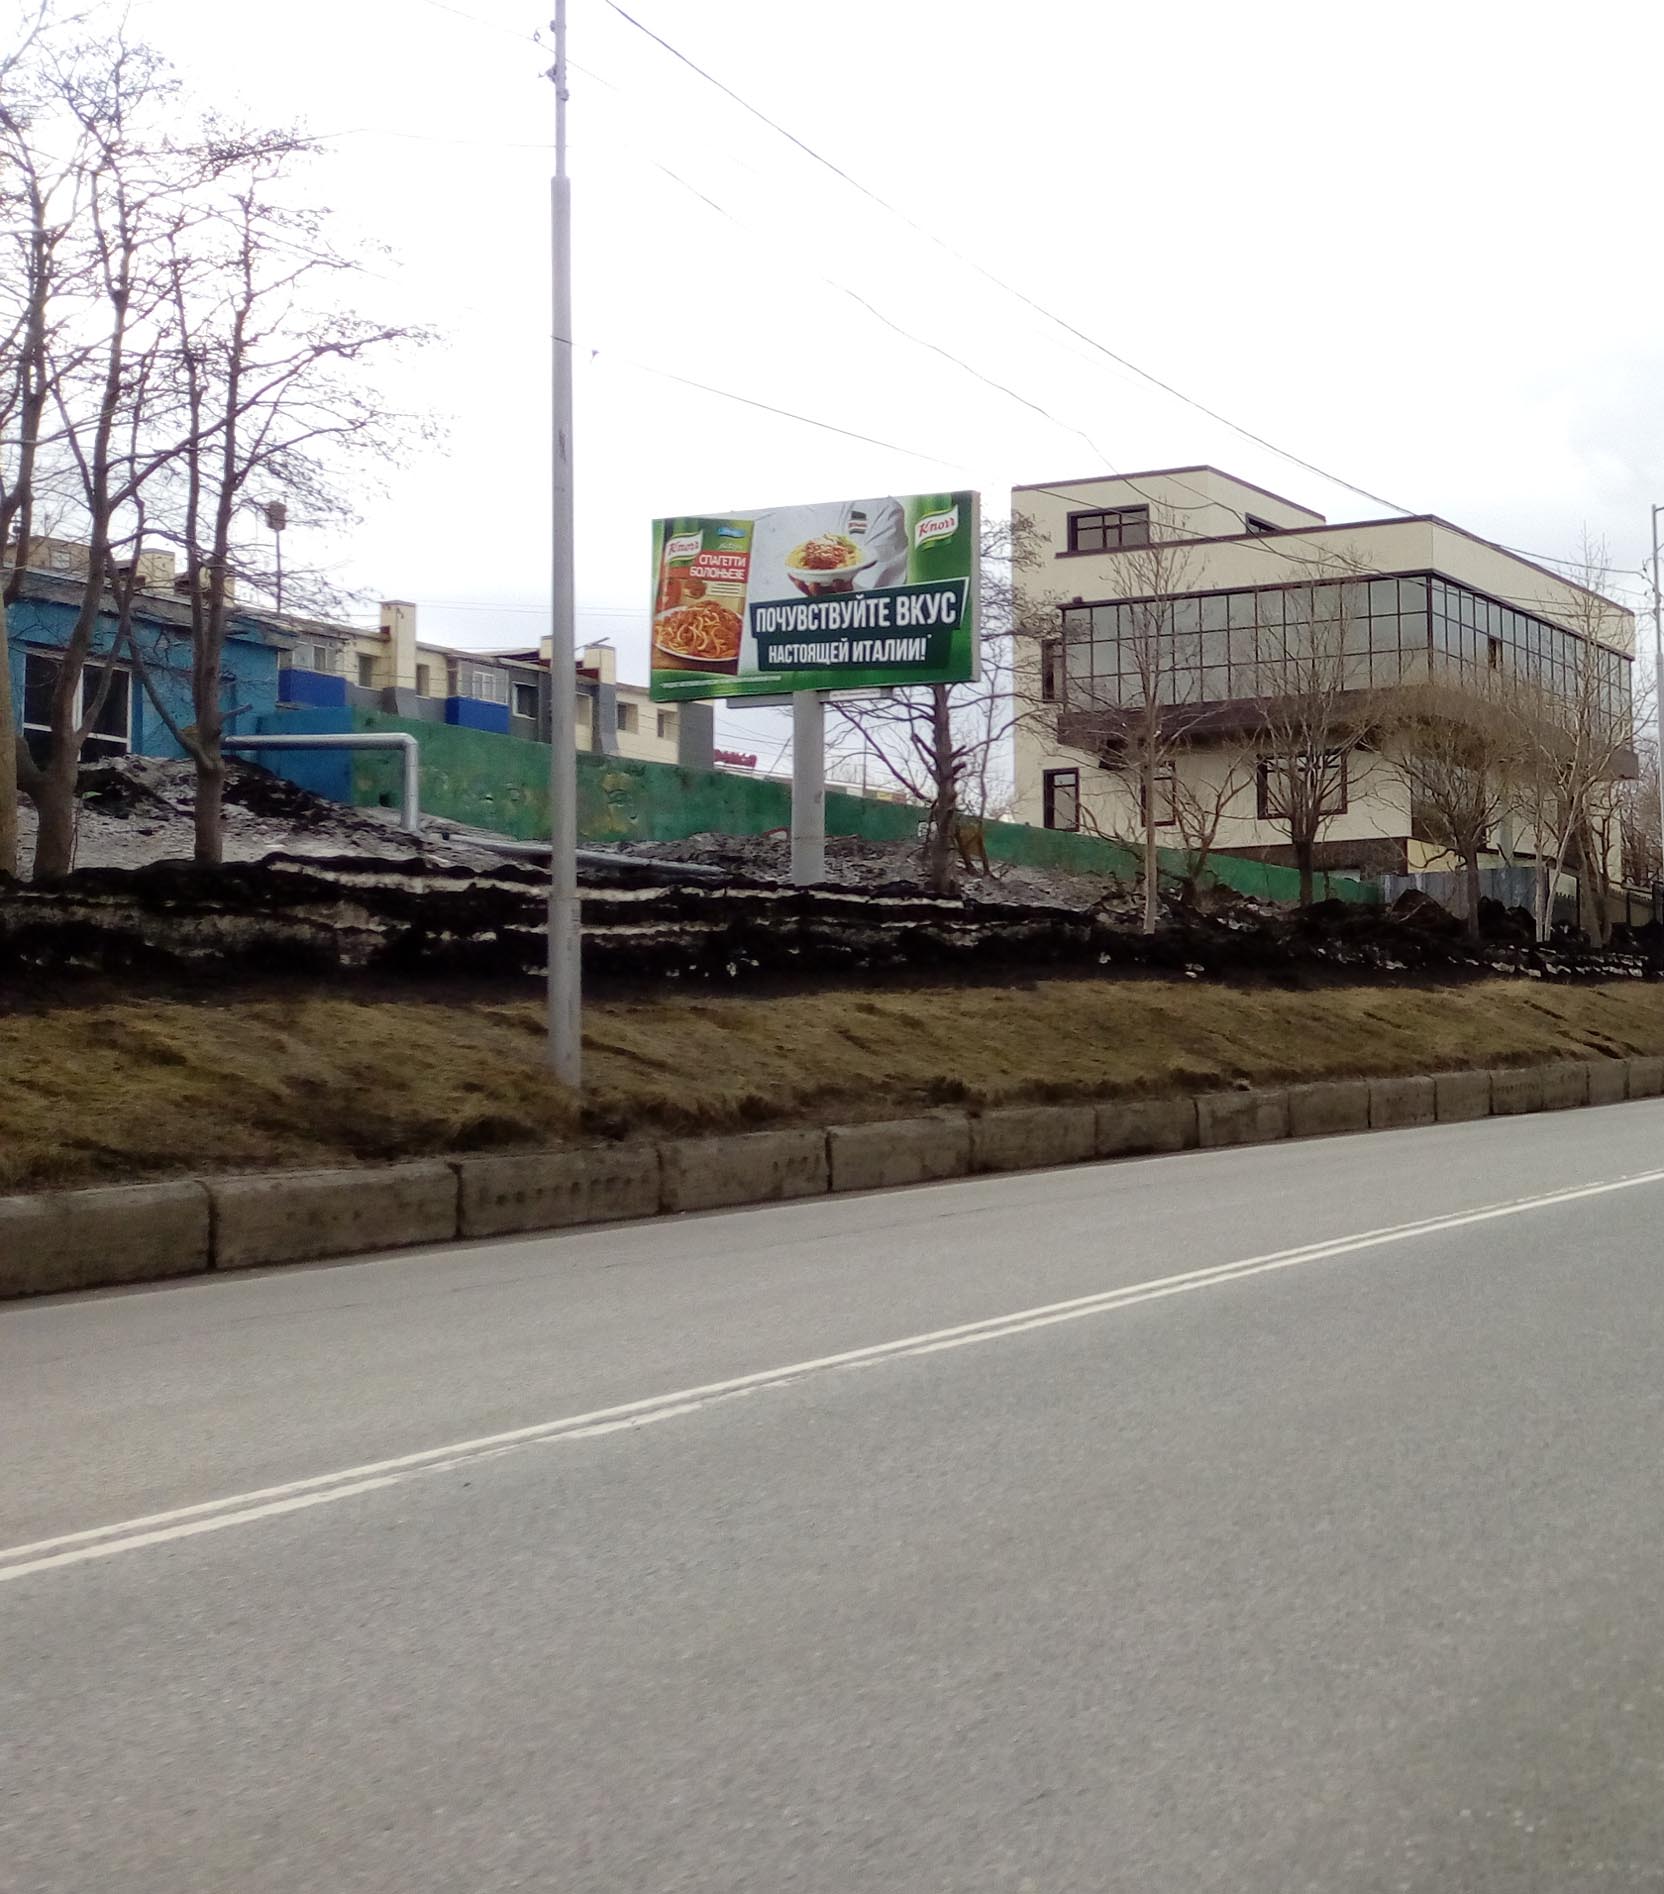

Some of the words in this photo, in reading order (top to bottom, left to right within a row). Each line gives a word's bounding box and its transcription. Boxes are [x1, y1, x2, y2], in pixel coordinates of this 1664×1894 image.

[918, 517, 955, 537] Knorr
[668, 541, 699, 556] Knorr
[699, 554, 746, 567] СПАГЕТТИ
[690, 566, 745, 580] БОЛОНЬЕЗЕ
[756, 594, 890, 633] ПОЧУВСТВУЙТЕ
[895, 591, 956, 627] ВКУС
[768, 637, 849, 665] НАСТОЯЩЕЙ
